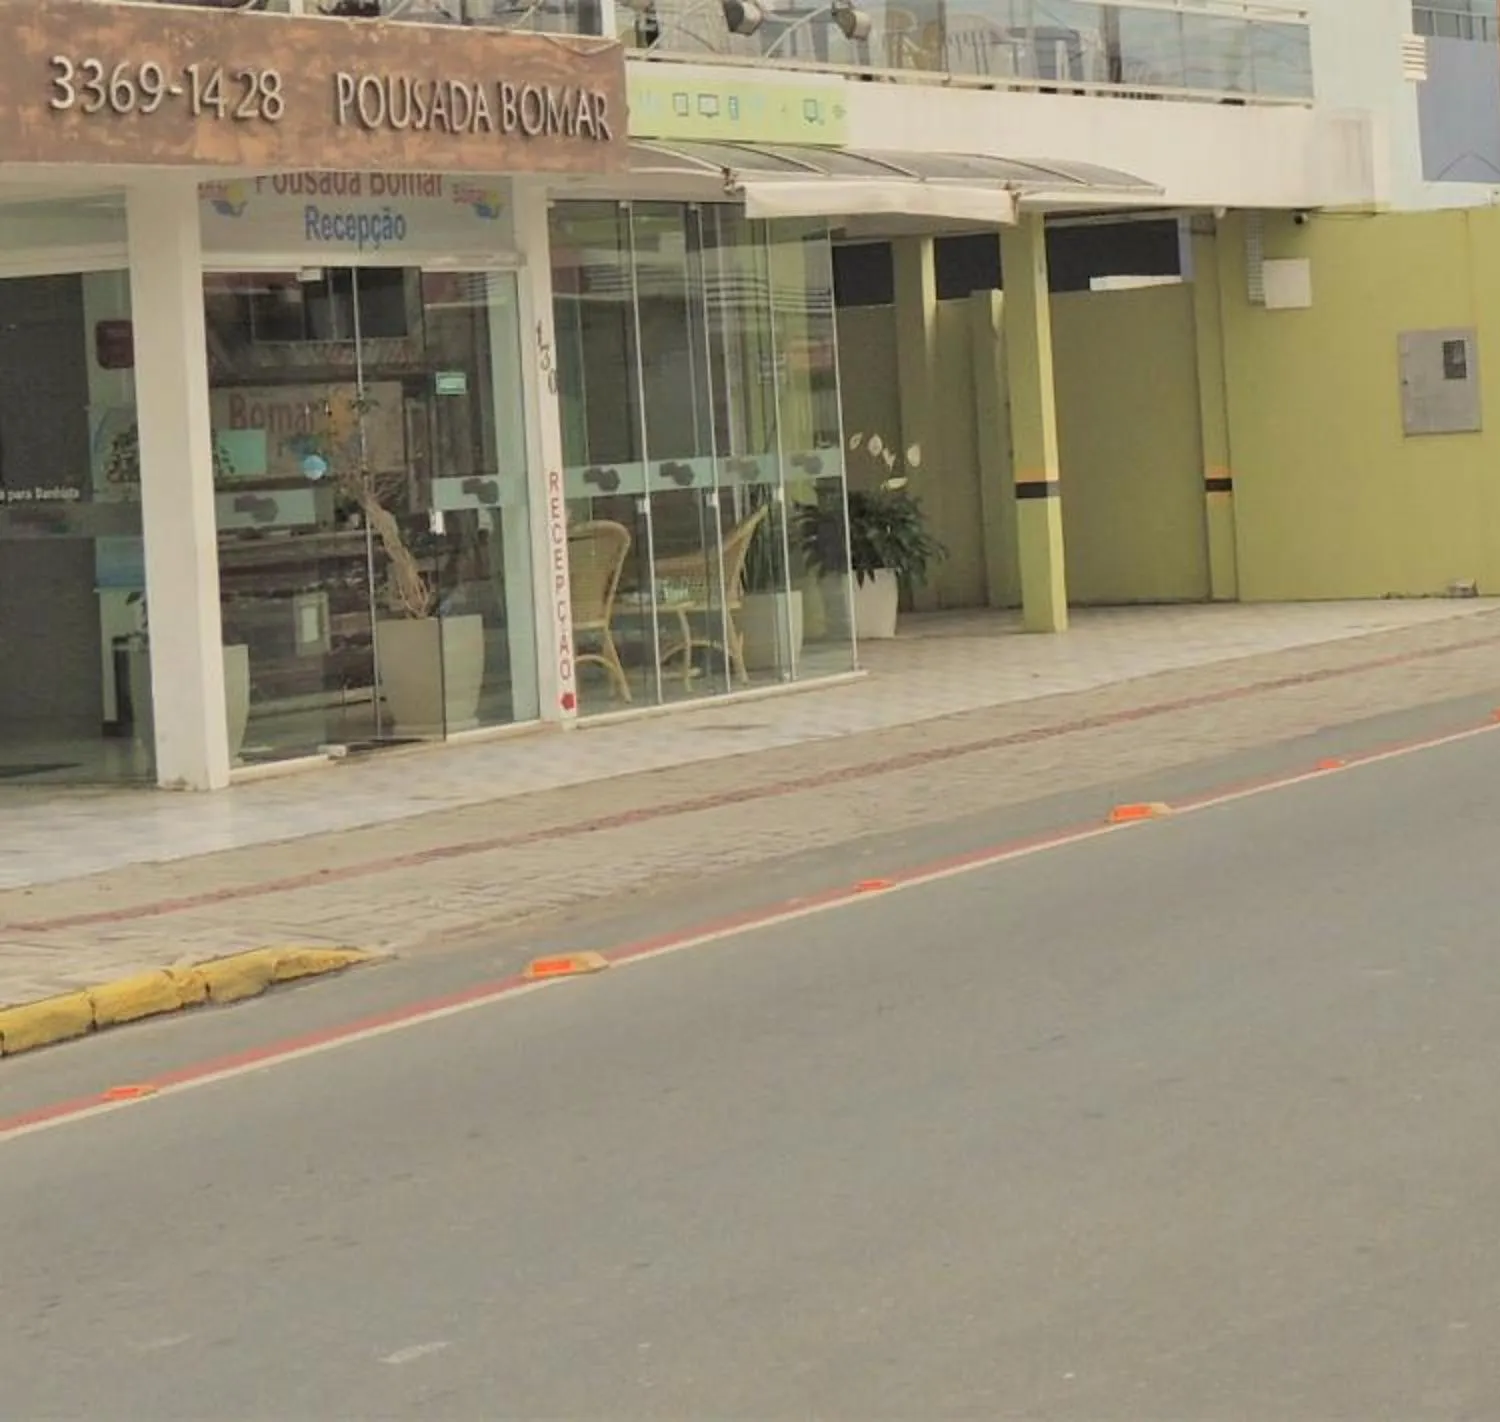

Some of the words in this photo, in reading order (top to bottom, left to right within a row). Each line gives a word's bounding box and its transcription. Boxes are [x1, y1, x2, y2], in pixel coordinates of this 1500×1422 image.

[50, 55, 285, 121] 3369-1428
[336, 71, 493, 132] POUSADA
[500, 80, 613, 141] BOMAR
[304, 204, 407, 251] Recepção
[549, 471, 571, 681] RECEPÇÃO
